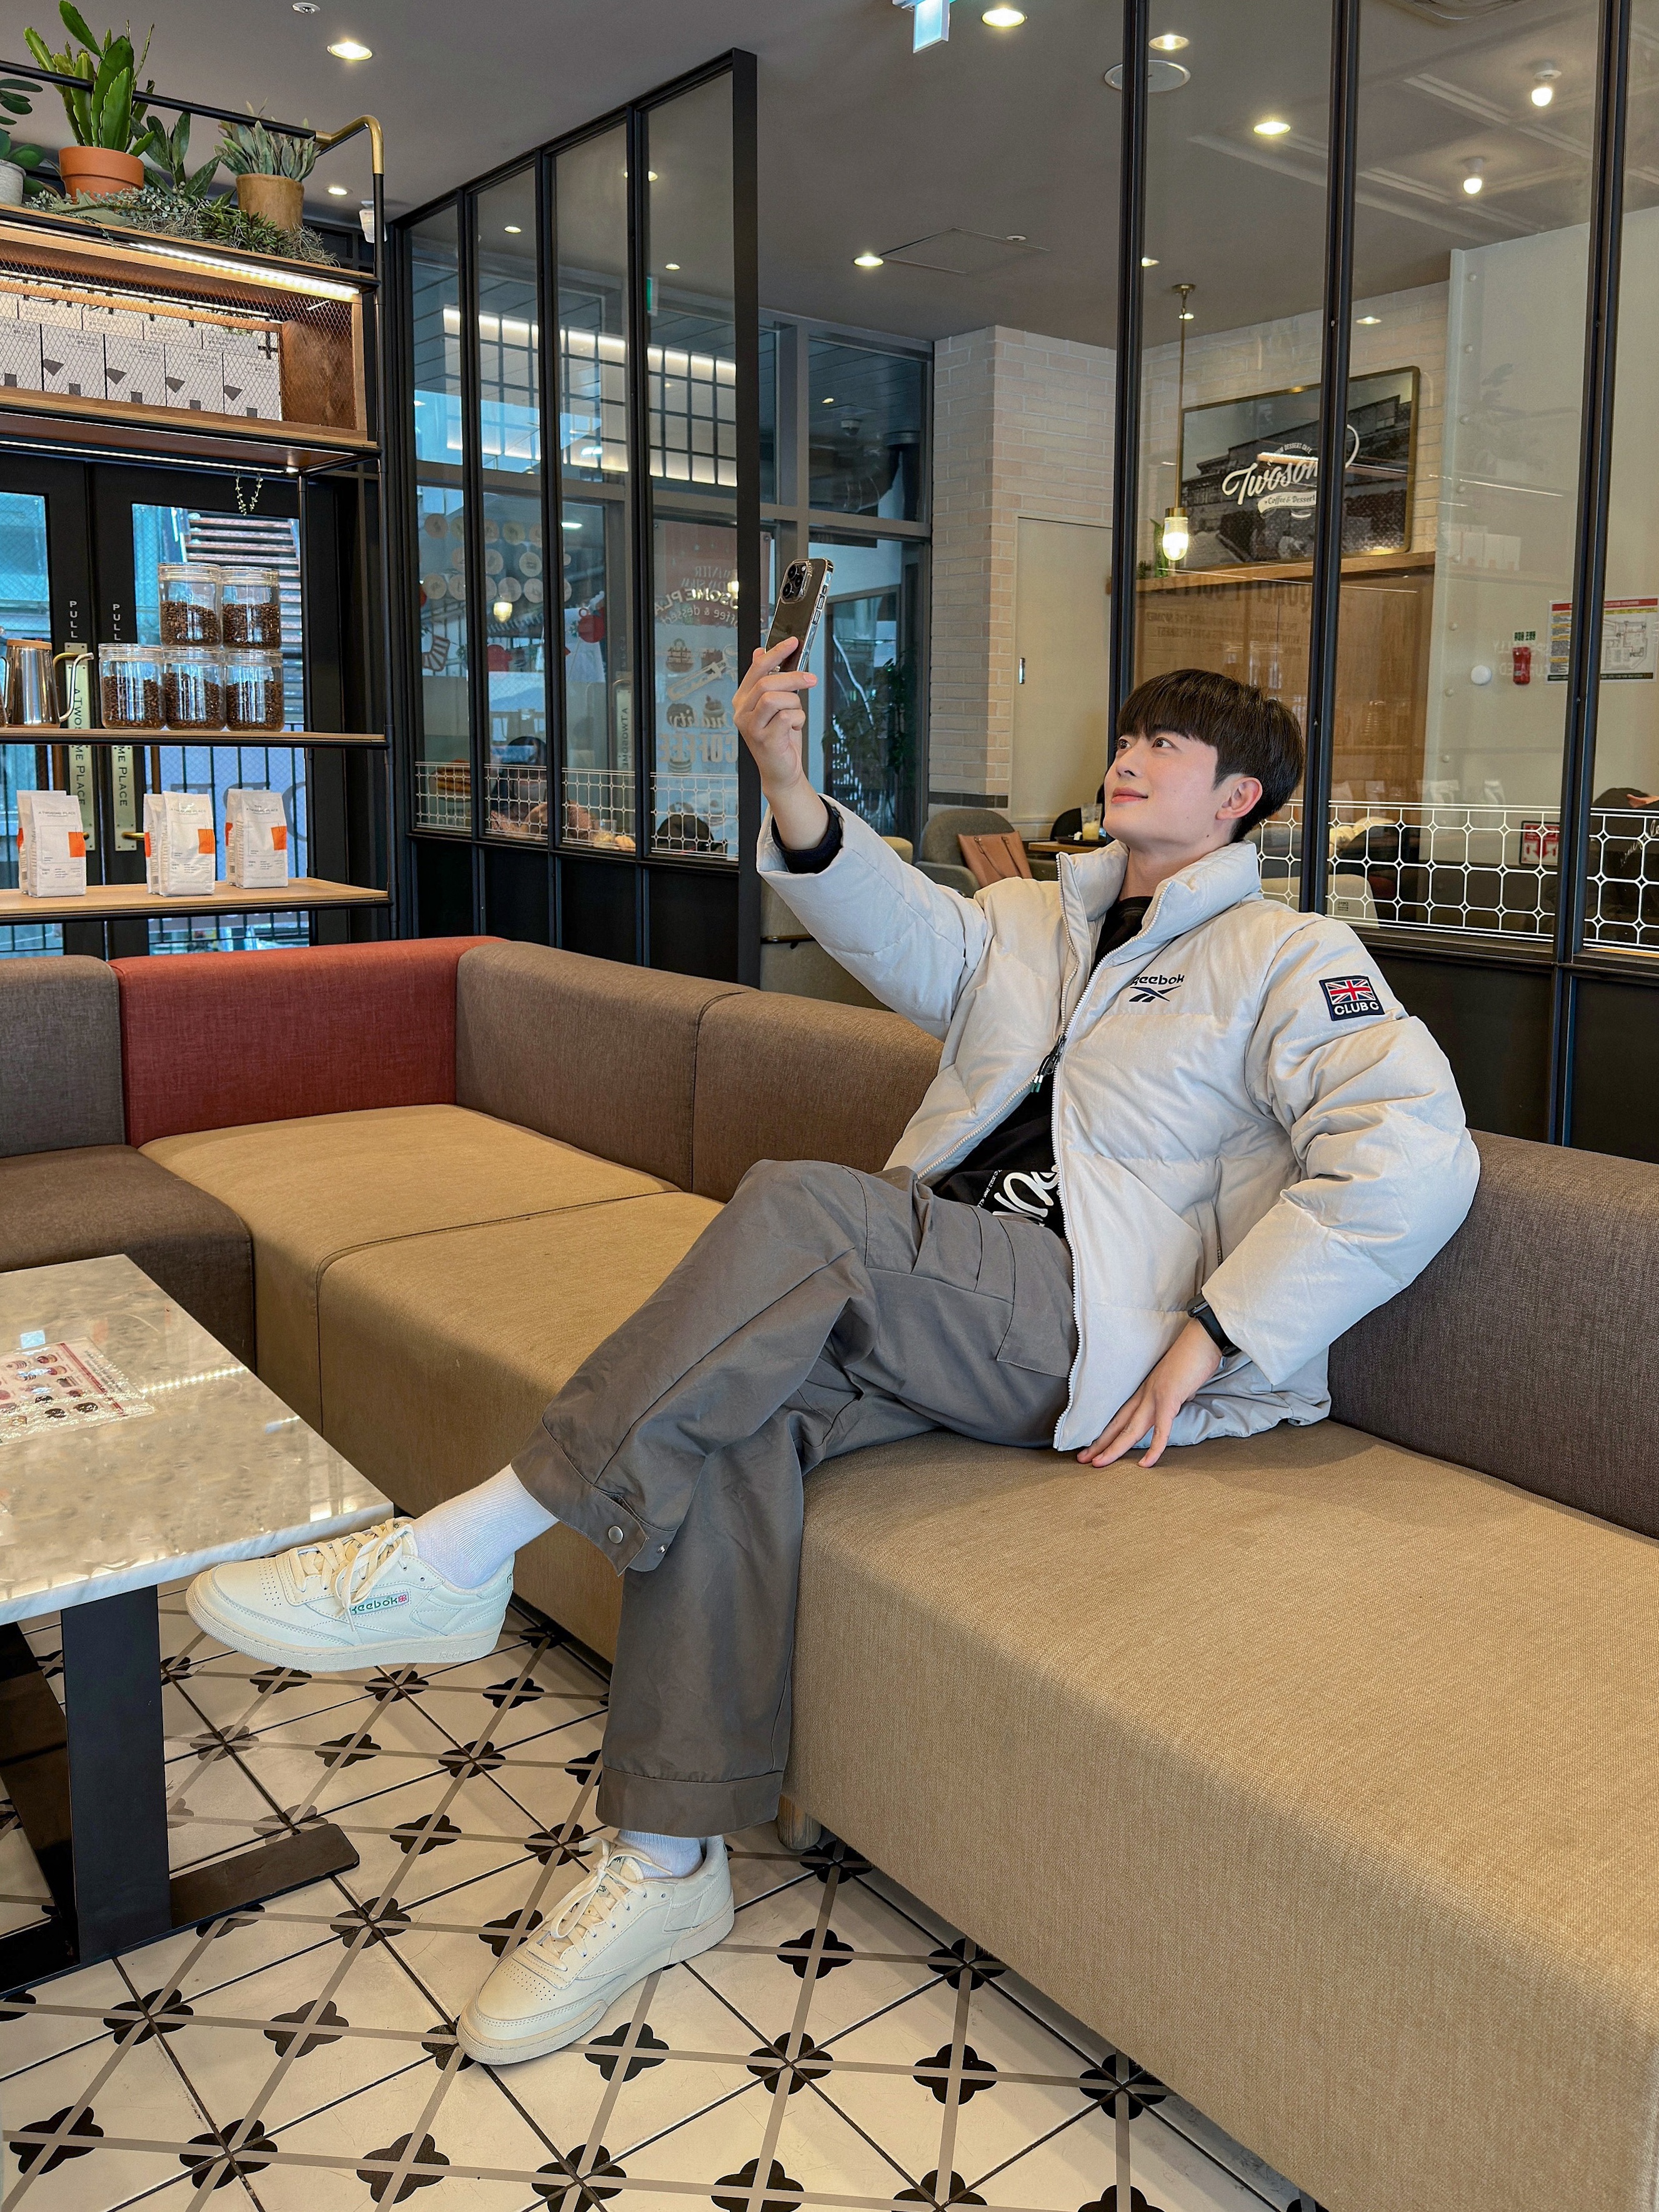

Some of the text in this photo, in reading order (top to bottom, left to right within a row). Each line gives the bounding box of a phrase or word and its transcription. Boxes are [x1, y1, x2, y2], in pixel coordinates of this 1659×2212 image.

[1268, 495, 1285, 504] Coffee
[69, 600, 78, 638] PULL
[112, 604, 121, 641] PULL
[76, 766, 86, 805] PLACE
[118, 767, 128, 806] PLACE
[1334, 1001, 1380, 1016] CLUB C
